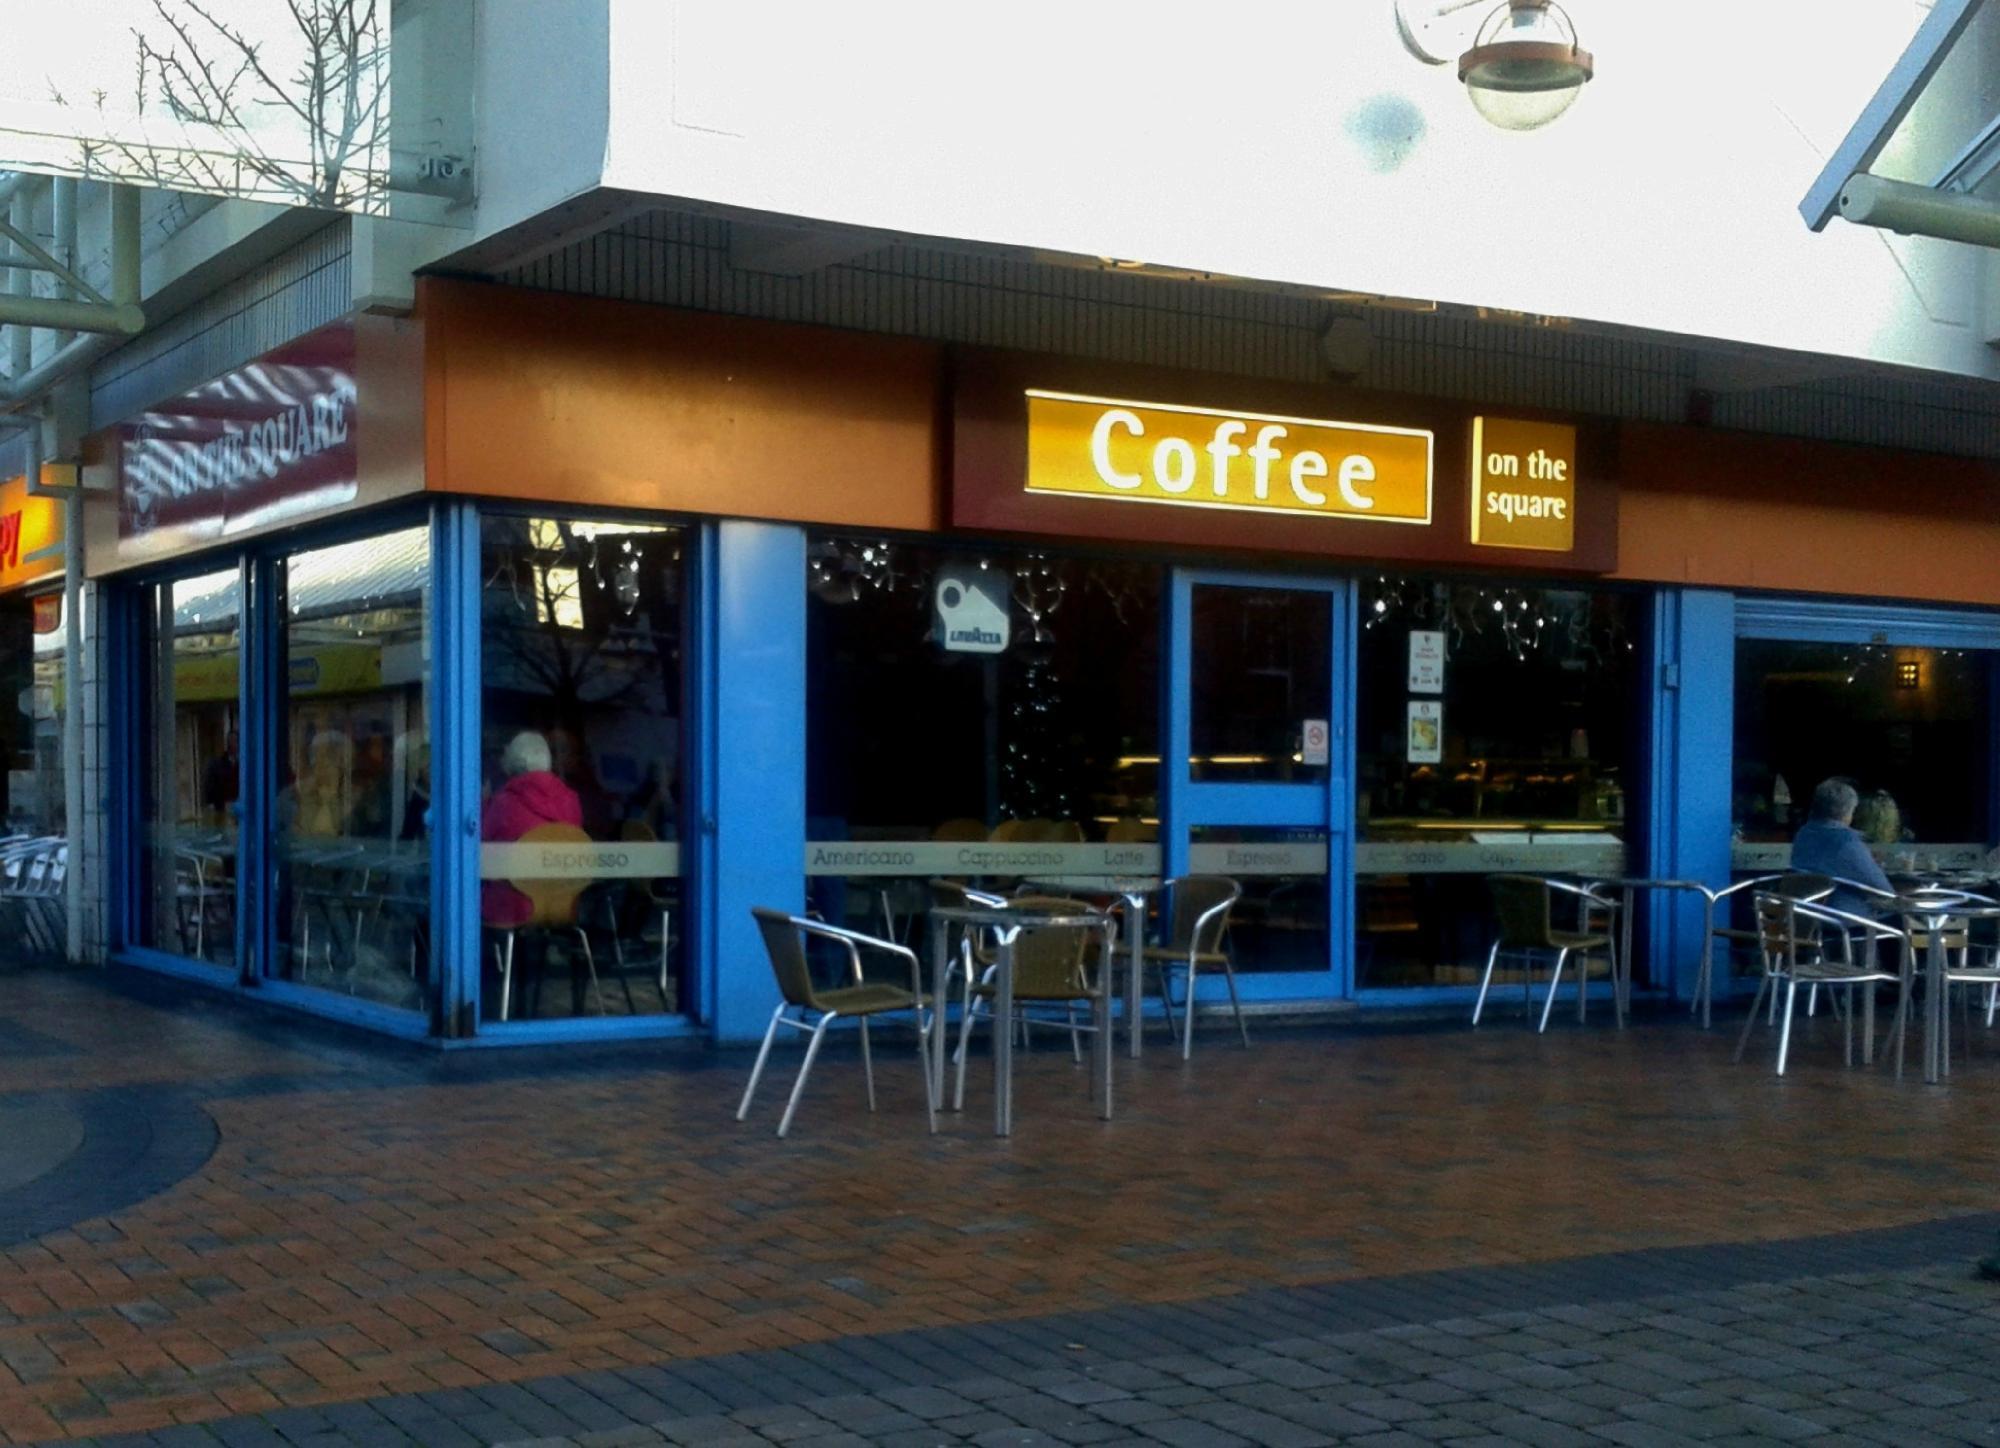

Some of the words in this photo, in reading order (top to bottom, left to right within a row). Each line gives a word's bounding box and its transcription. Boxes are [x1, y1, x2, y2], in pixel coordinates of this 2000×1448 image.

[248, 394, 348, 478] SQUARE
[1091, 409, 1376, 509] Coffee
[1487, 453, 1518, 476] on
[1527, 449, 1567, 481] the
[1487, 491, 1567, 523] square
[541, 850, 629, 872] Espresso
[814, 848, 915, 866] Americano
[958, 848, 1065, 869] Cappuccino
[1104, 848, 1144, 865] Latte
